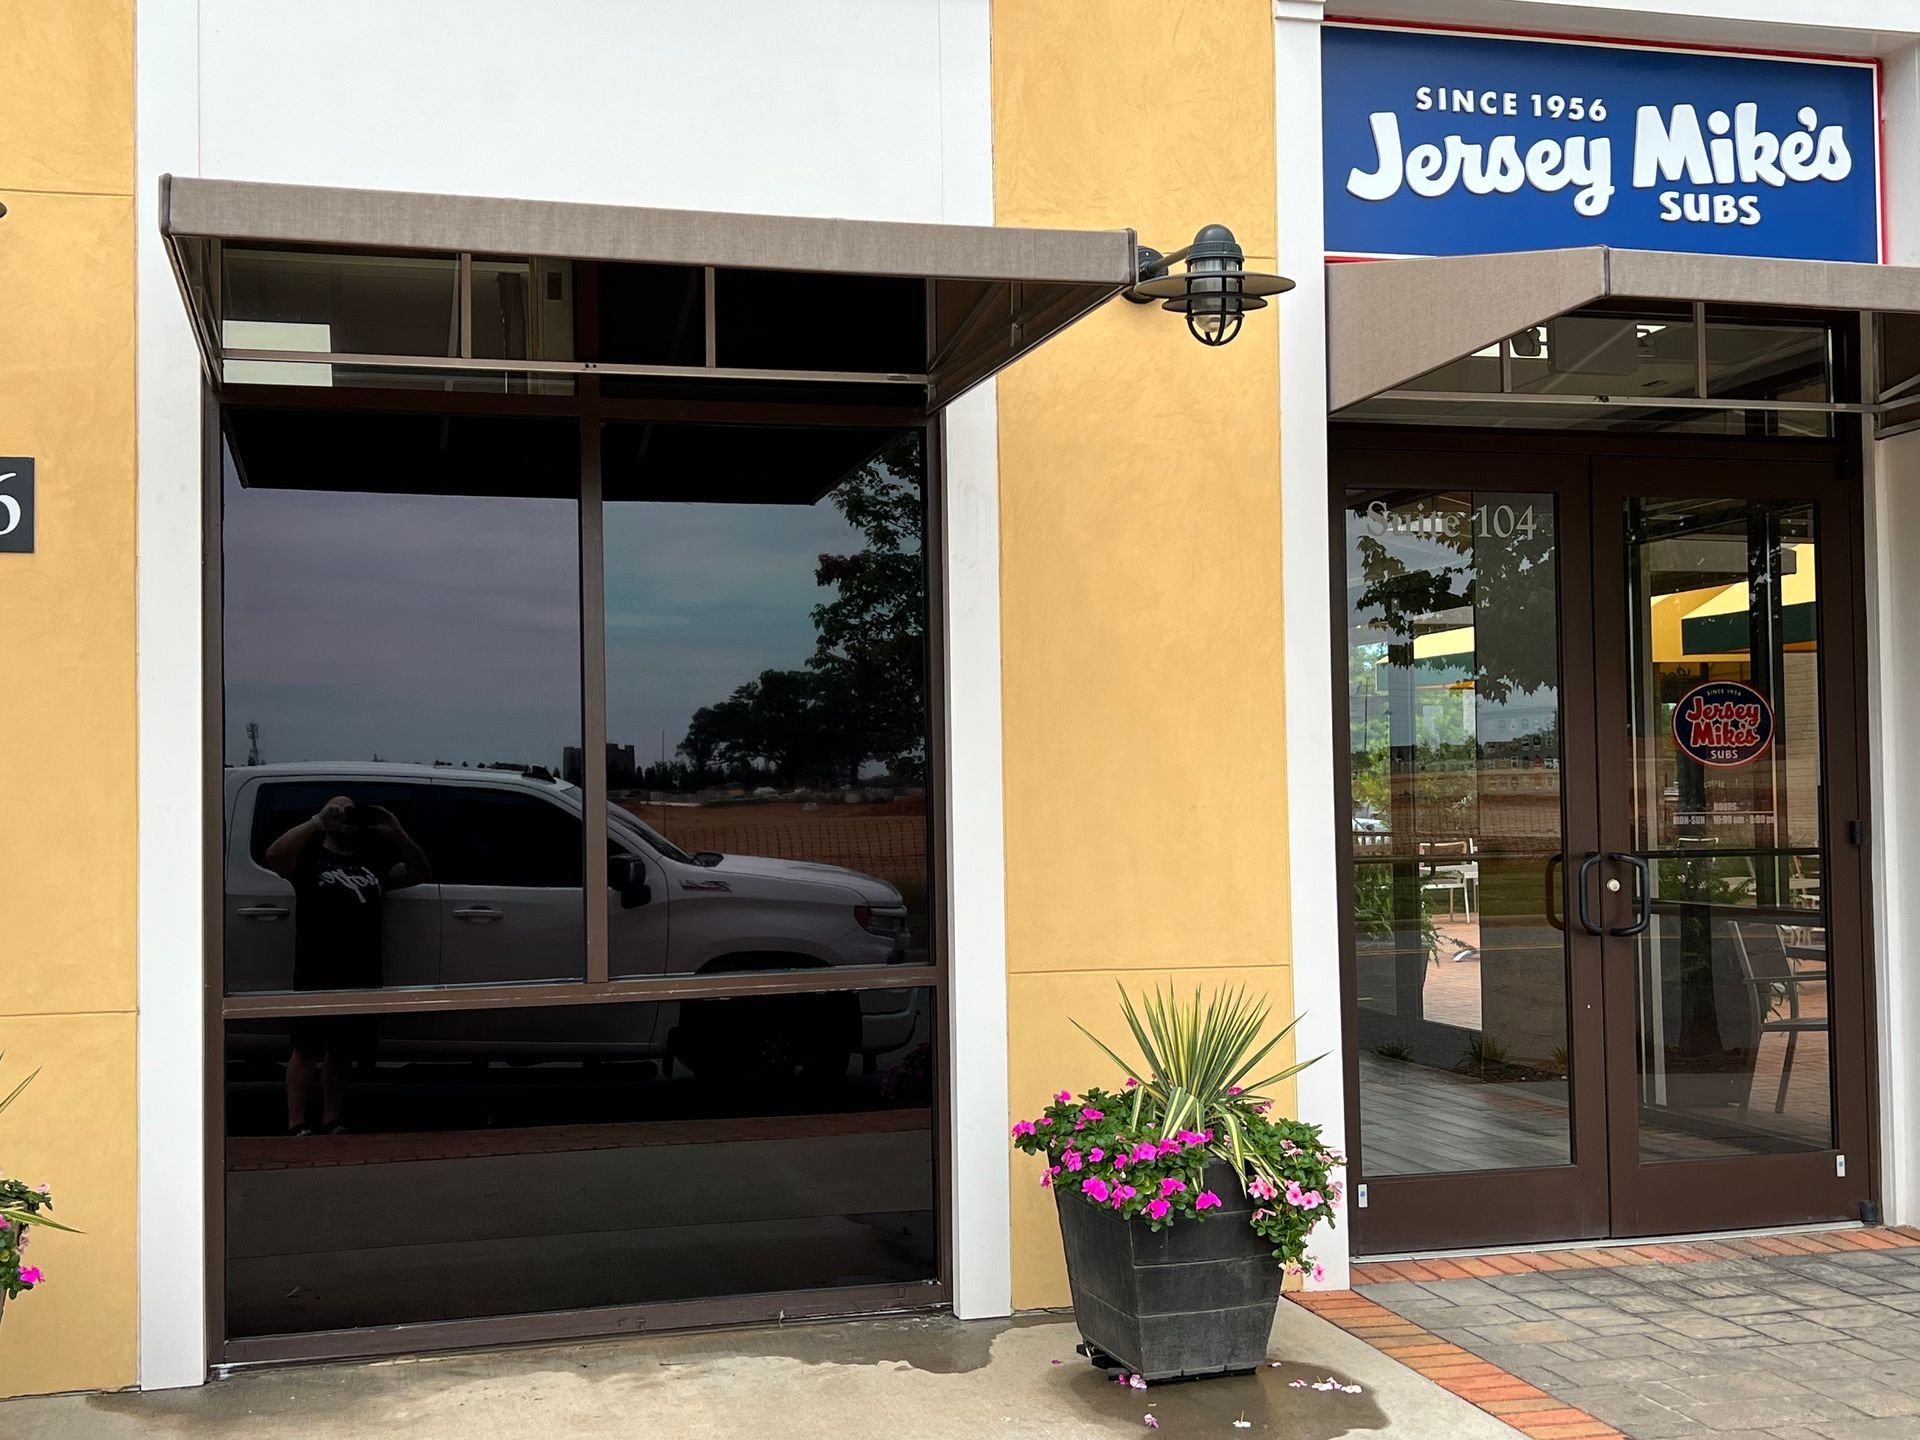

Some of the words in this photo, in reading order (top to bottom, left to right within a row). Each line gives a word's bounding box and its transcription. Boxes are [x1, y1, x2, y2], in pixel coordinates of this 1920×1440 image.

[1416, 86, 1517, 117] SINCE
[1530, 94, 1608, 122] 1956
[1346, 111, 1615, 217] Jersey
[1632, 102, 1854, 189] Mike's
[1659, 191, 1761, 226] SUBS
[1367, 500, 1461, 537] Suite
[1477, 504, 1537, 540] 104
[1706, 688, 1725, 696] SINCE
[1685, 696, 1761, 728] Jersey
[1690, 719, 1760, 747] Mike's
[1710, 749, 1738, 759] SUBS
[1713, 802, 1737, 811] HOURS
